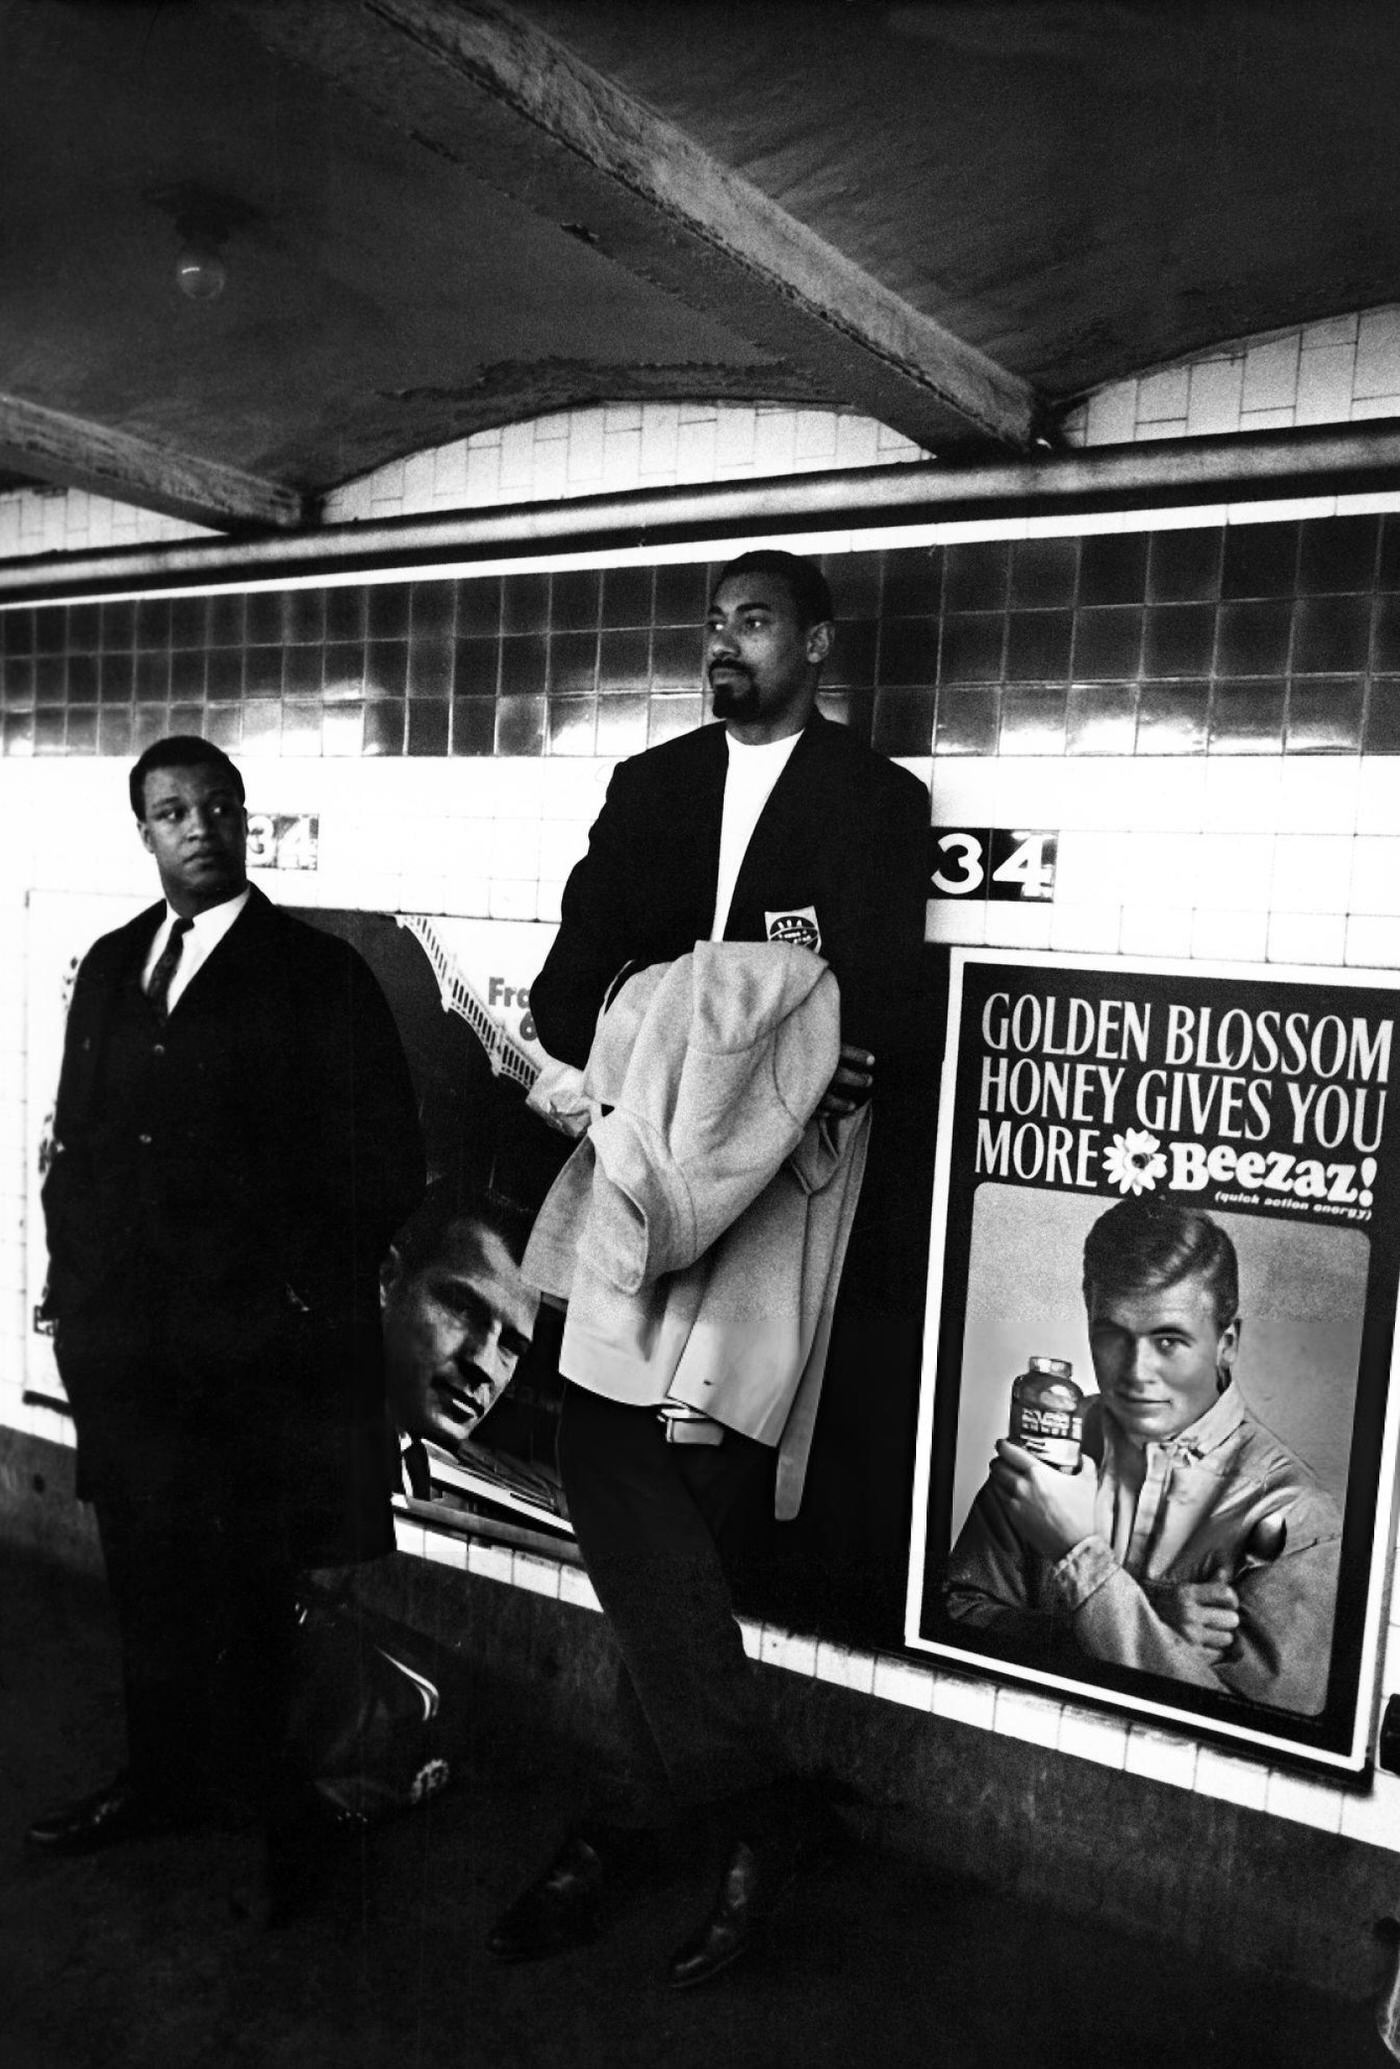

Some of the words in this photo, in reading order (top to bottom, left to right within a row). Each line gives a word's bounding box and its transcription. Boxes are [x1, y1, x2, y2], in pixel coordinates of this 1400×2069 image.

[246, 815, 315, 869] 34
[930, 832, 1053, 898] 34
[981, 992, 1152, 1063] GOLDEN
[1165, 1004, 1394, 1083] BLOSSOM
[978, 1055, 1126, 1124] HONEY
[1135, 1069, 1272, 1141] GIVES
[1287, 1082, 1387, 1153] YOU
[974, 1118, 1101, 1188] MORE
[1168, 1141, 1378, 1207] Beezaz!
[1214, 1190, 1260, 1205] (quick
[1264, 1197, 1310, 1210] action
[1313, 1203, 1373, 1221] energy)
